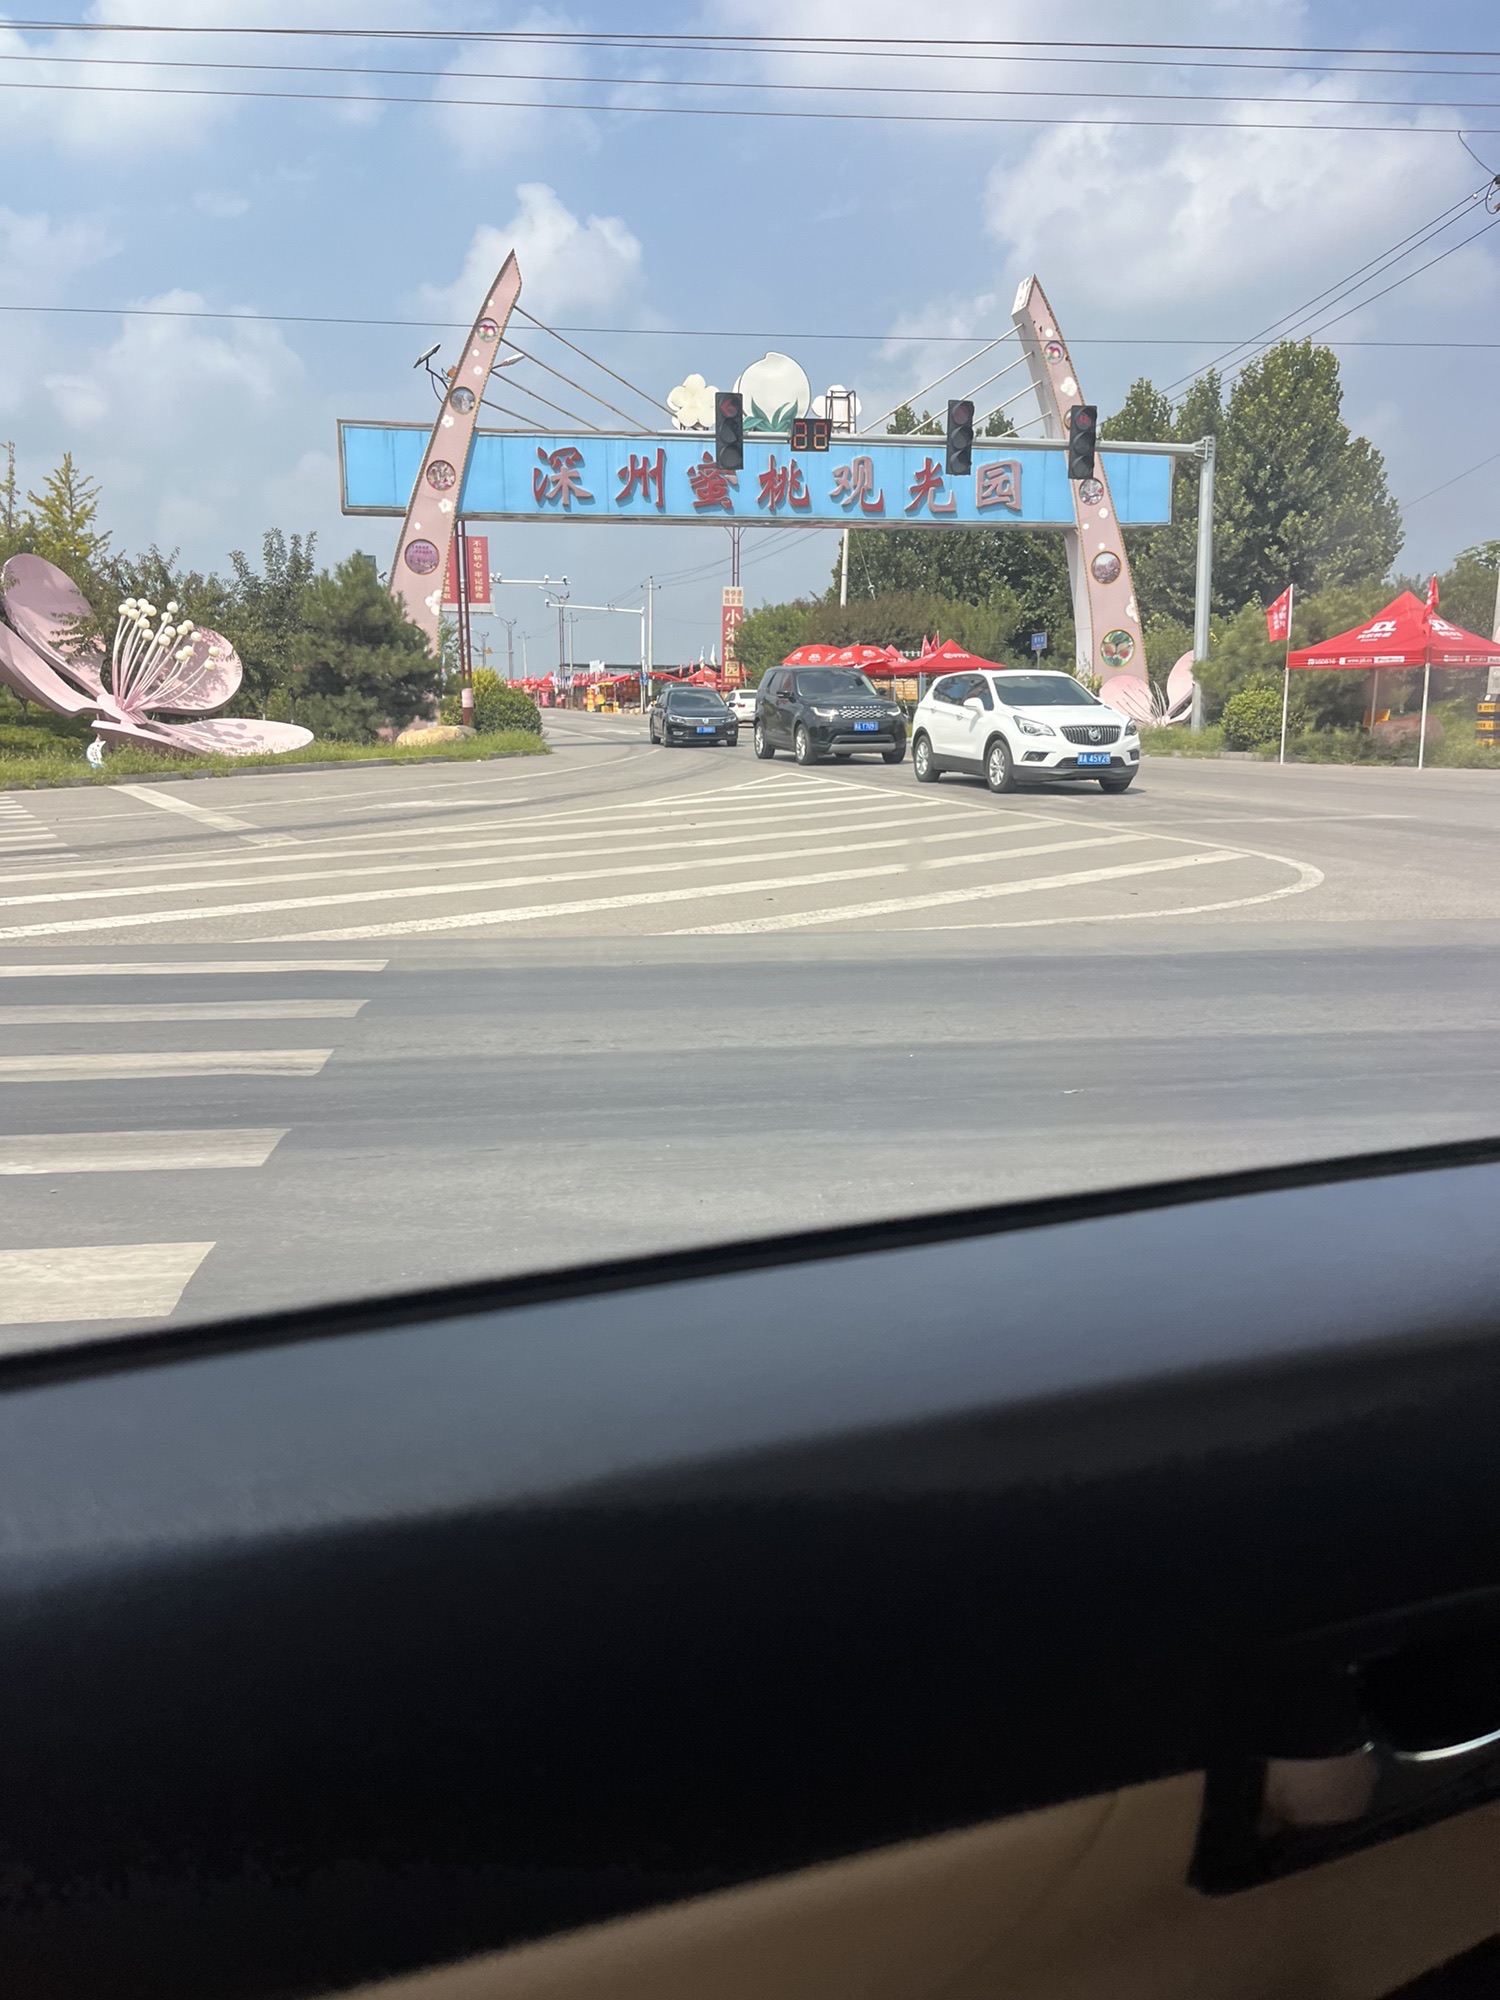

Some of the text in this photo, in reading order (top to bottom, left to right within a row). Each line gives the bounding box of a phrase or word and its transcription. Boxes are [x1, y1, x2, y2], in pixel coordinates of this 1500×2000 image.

[532, 446, 1023, 513] 深州蜜桃观光园
[1362, 621, 1397, 634] JDL
